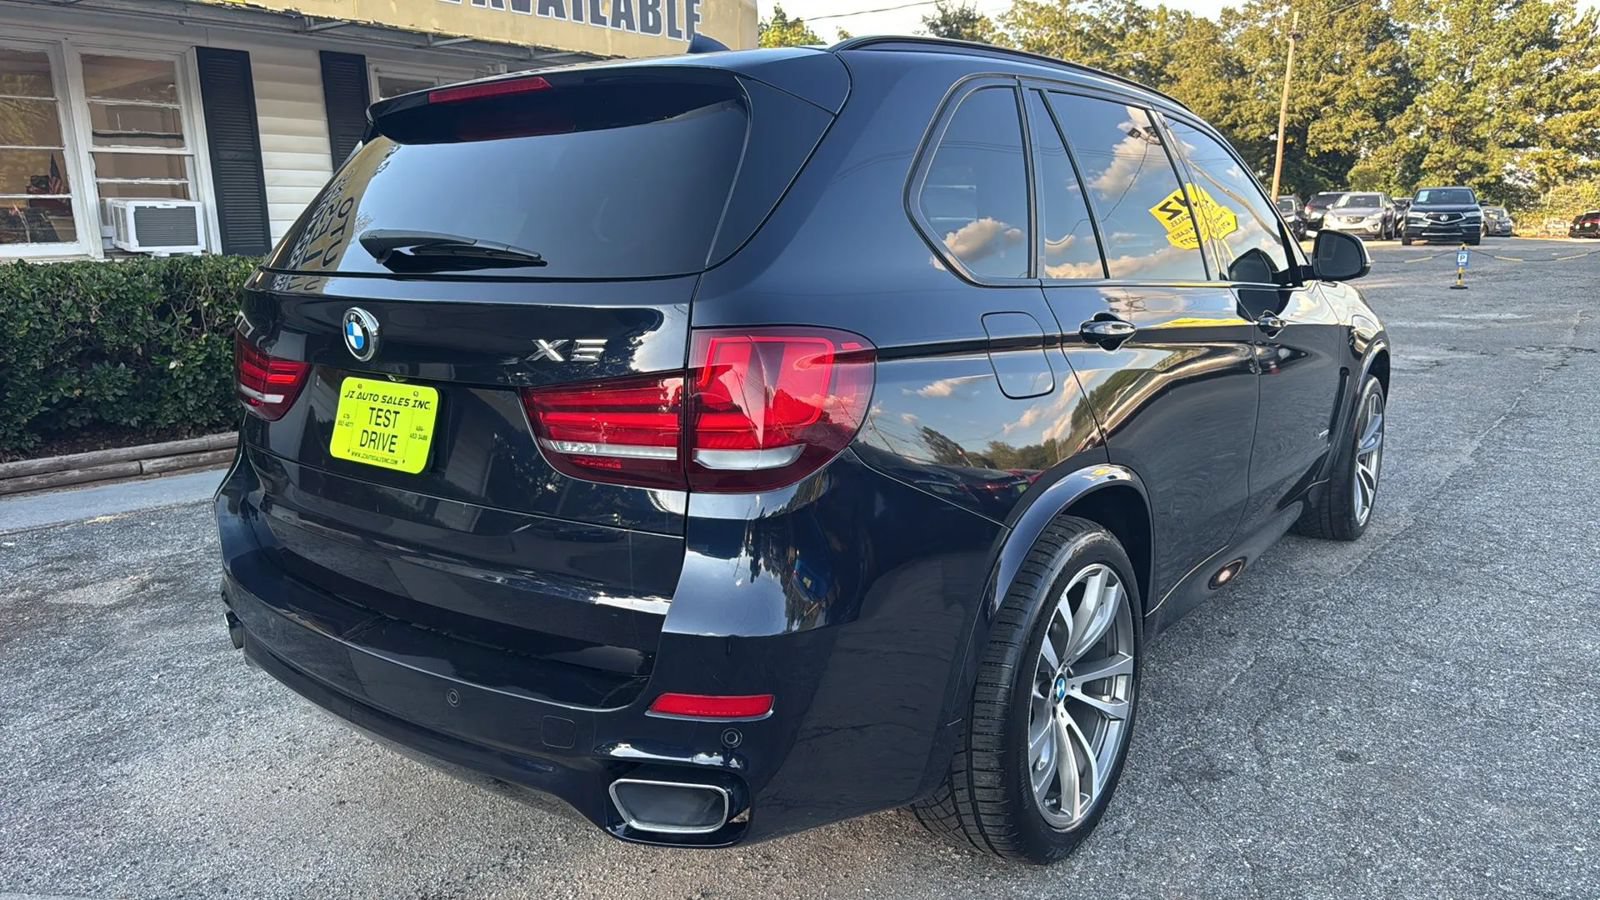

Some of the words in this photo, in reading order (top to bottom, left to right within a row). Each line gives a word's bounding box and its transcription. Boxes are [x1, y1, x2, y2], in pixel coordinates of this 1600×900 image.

[470, 0, 702, 42] LABLE
[525, 339, 609, 362] X5
[344, 390, 356, 399] JZ
[356, 392, 379, 402] AUTO
[381, 395, 411, 407] SALES
[368, 406, 400, 429] TEST
[359, 429, 399, 454] DRIVE
